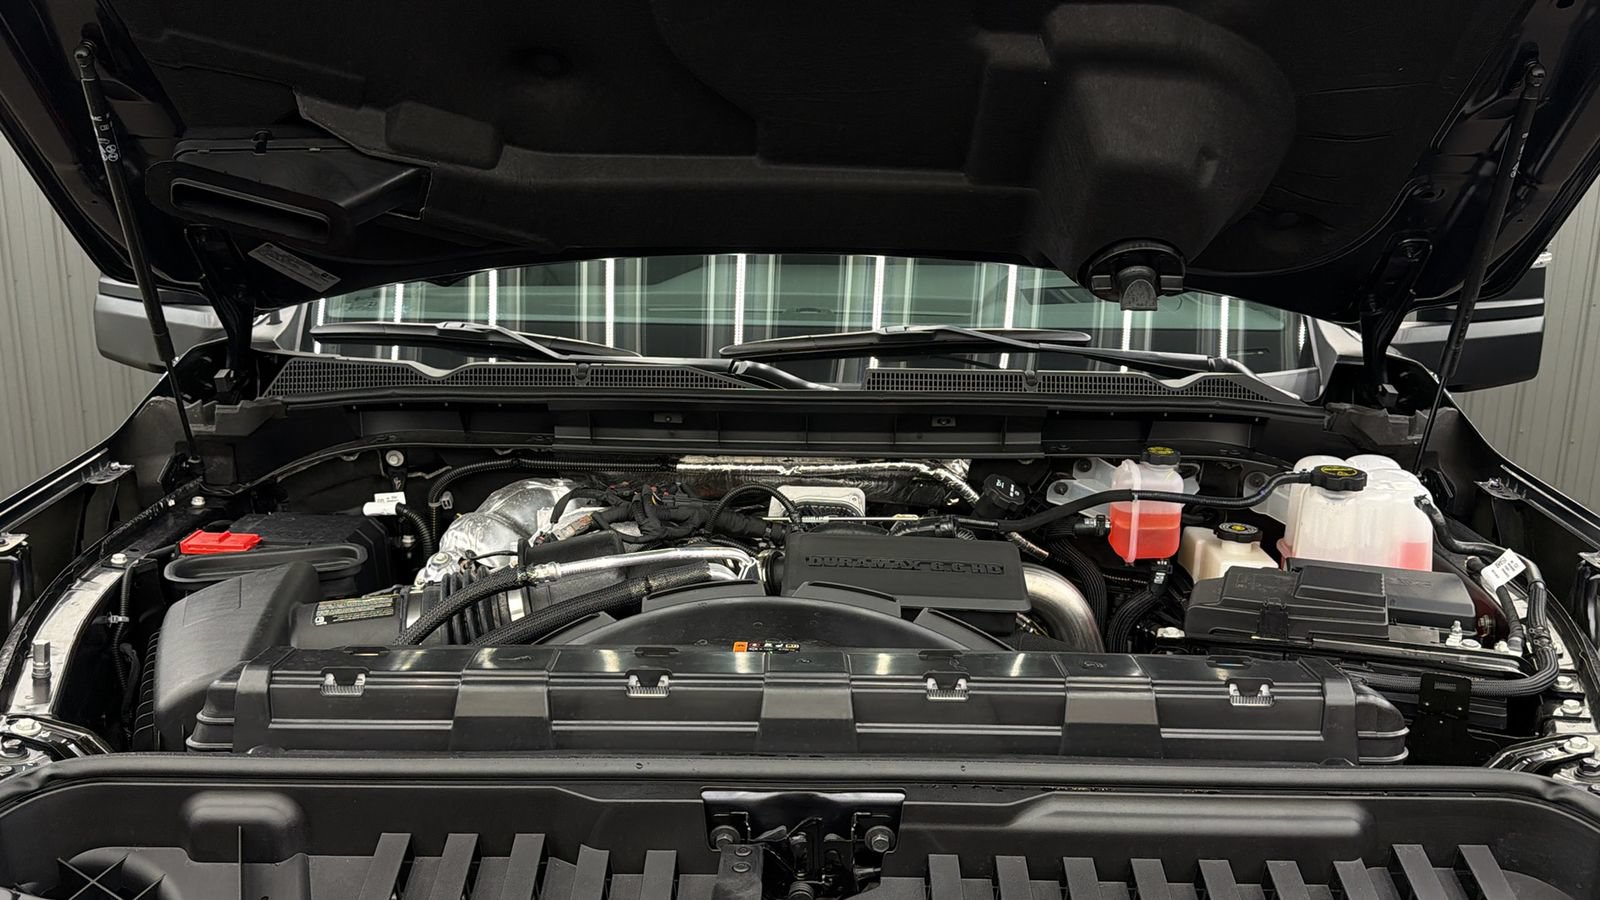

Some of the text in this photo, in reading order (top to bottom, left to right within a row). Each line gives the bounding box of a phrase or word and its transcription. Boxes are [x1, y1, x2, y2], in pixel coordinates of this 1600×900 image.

[806, 556, 1005, 575] DURAMAX 6.6 HD
